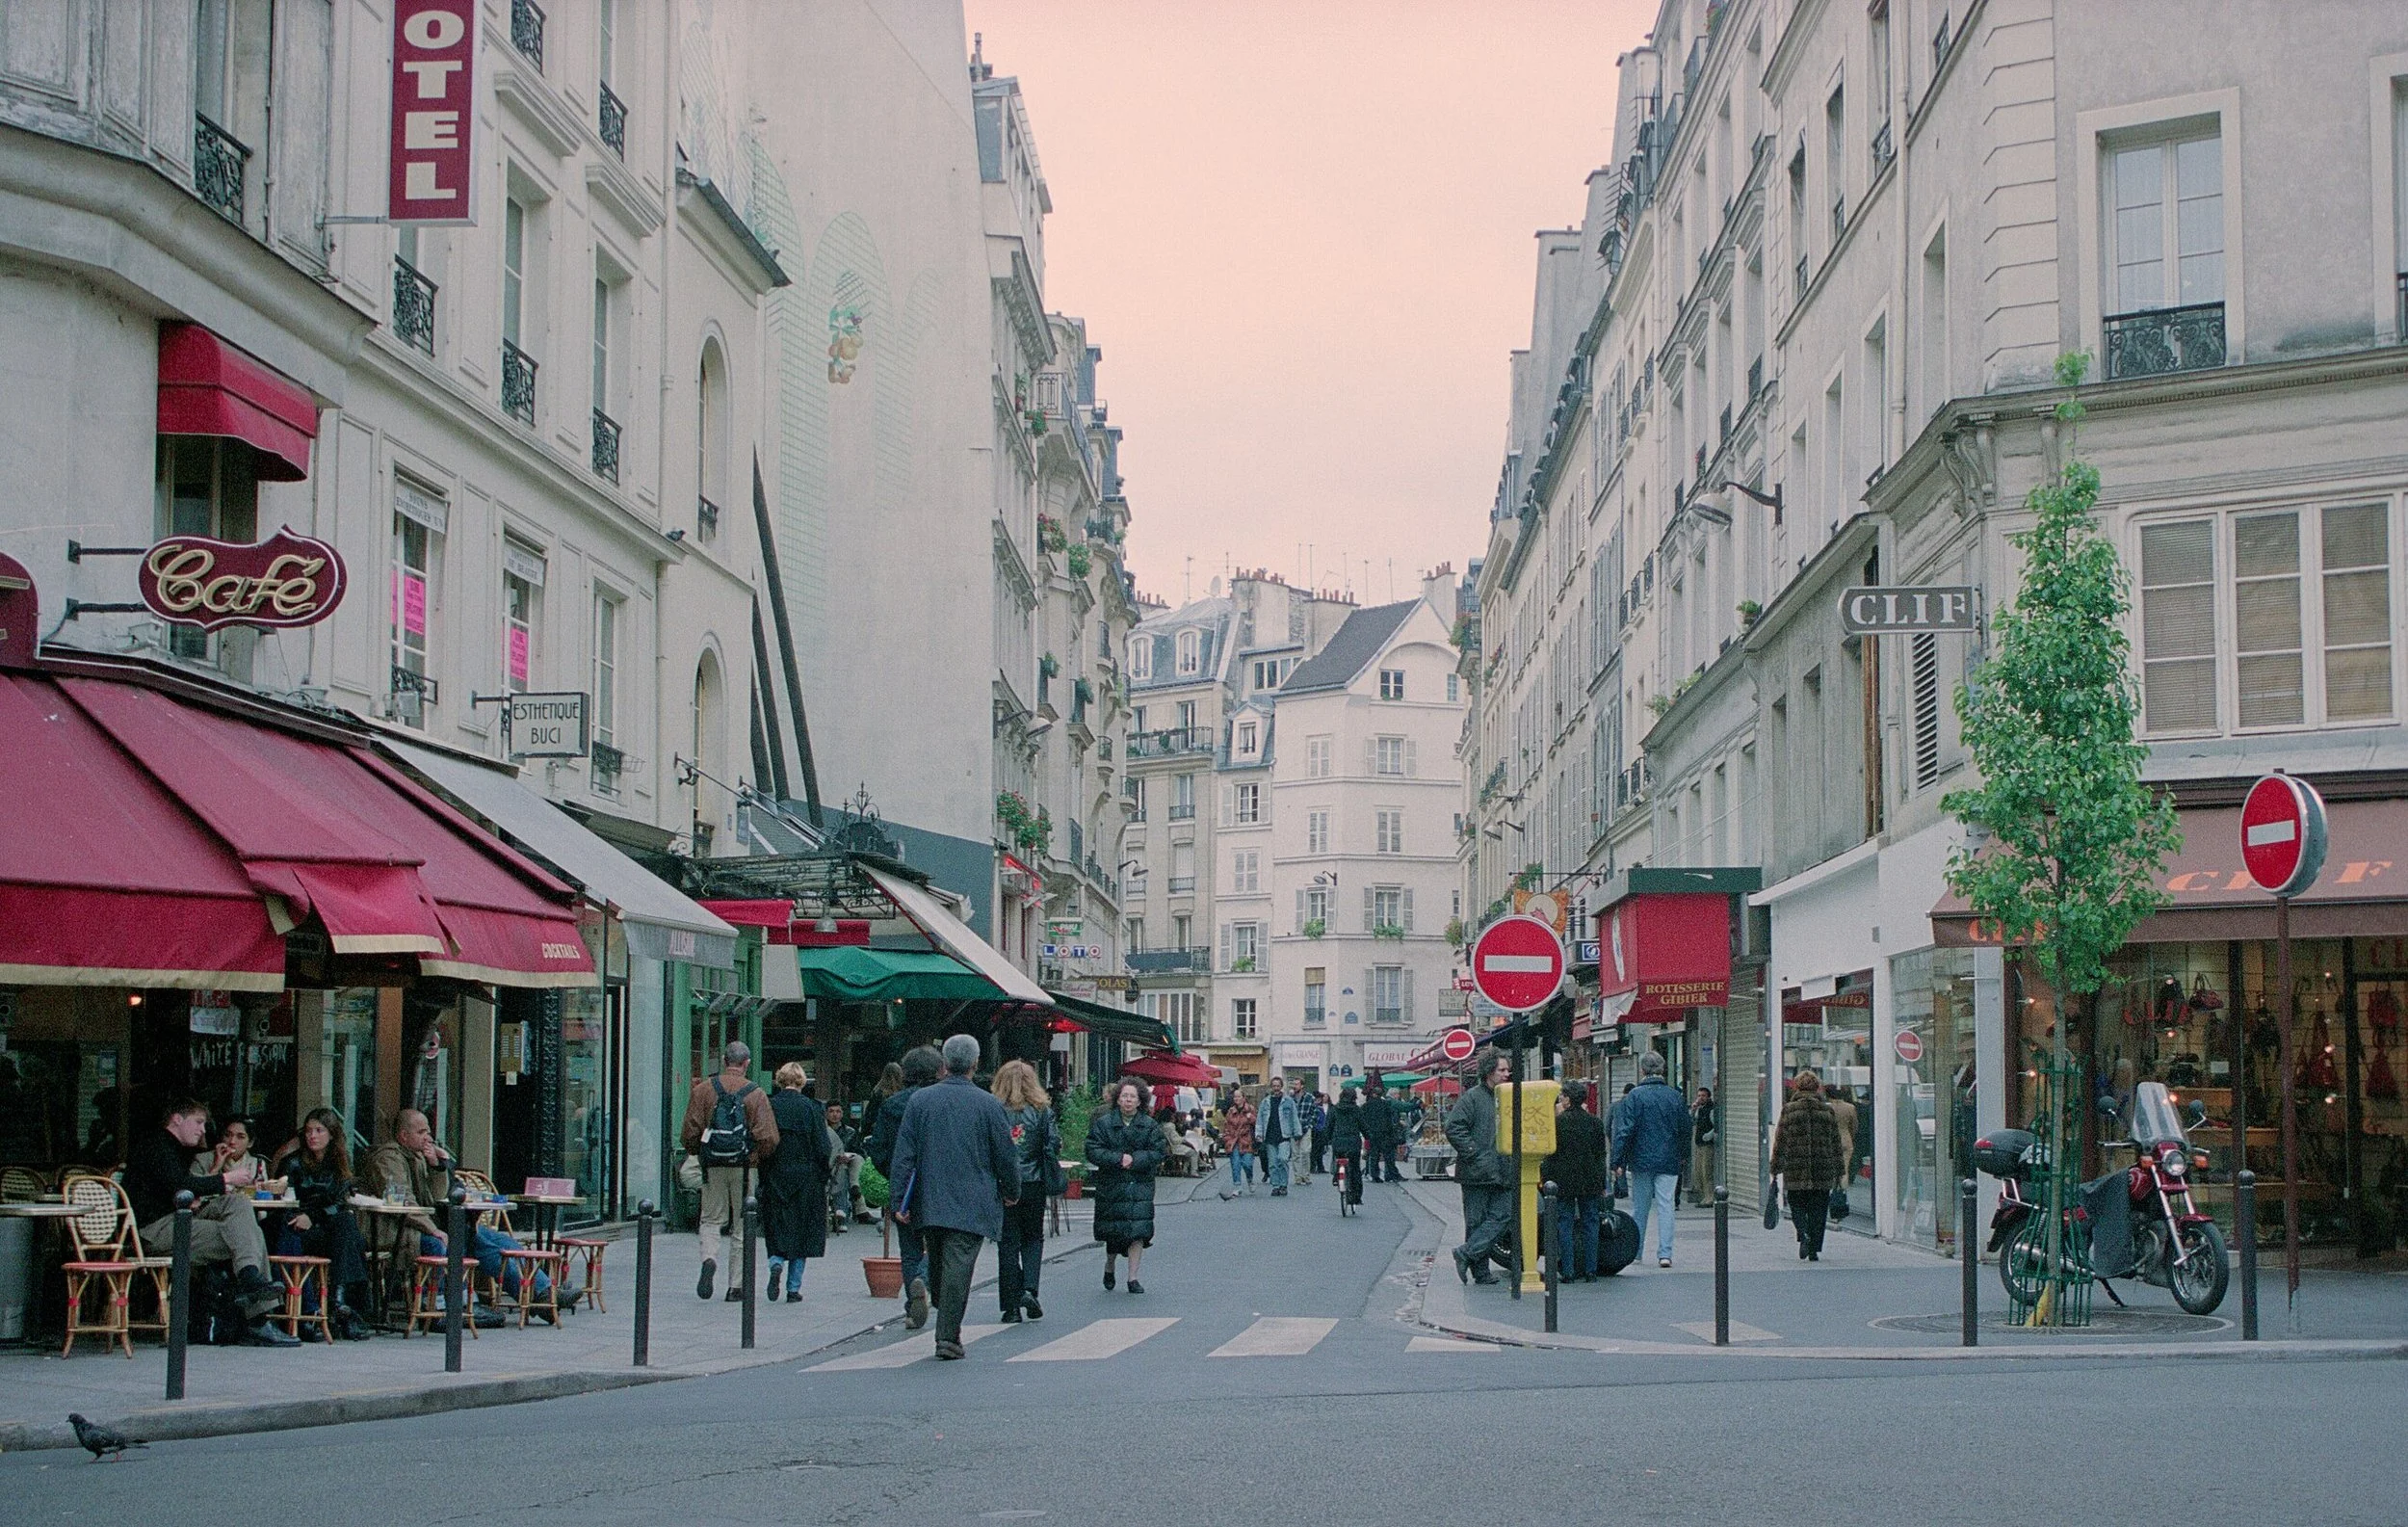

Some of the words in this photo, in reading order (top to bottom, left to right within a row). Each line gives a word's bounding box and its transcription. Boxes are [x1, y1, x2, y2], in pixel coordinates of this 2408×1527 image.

[403, 10, 465, 200] OTEL
[148, 543, 327, 616] Café
[1850, 594, 1966, 624] CLIF
[513, 702, 579, 721] ESTHETIQUE
[531, 727, 561, 744] BUCI
[2167, 861, 2393, 891] CLF
[541, 942, 580, 959] COCKTAILS
[1043, 944, 1101, 959] LOTO
[1646, 982, 1724, 994] ROTISSERIE
[1661, 993, 1708, 1005] GIBIER
[1369, 1052, 1405, 1062] GLOBAL
